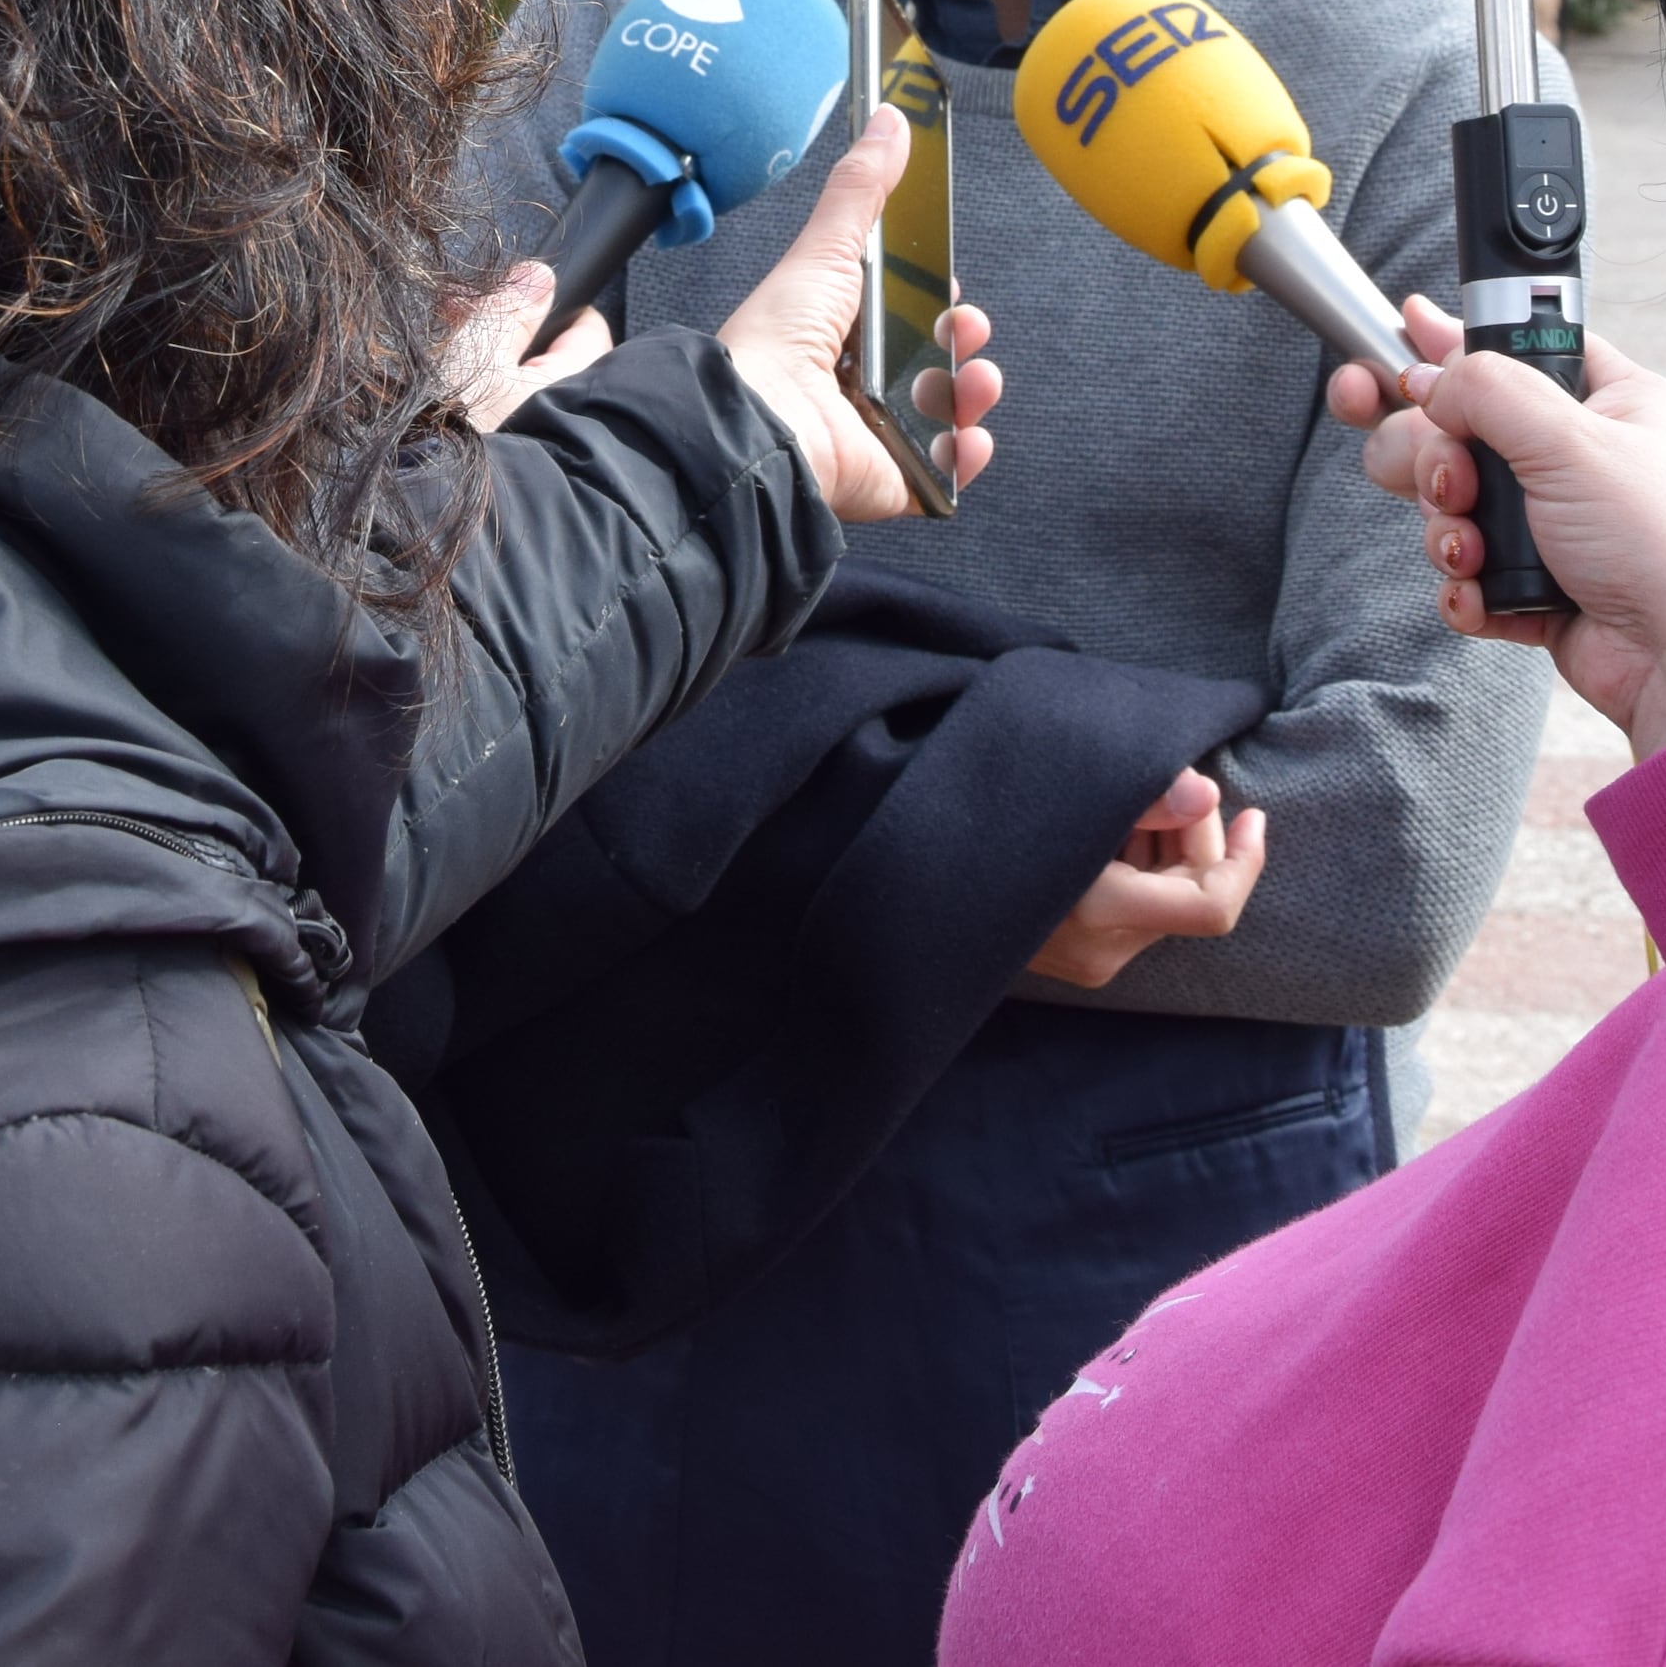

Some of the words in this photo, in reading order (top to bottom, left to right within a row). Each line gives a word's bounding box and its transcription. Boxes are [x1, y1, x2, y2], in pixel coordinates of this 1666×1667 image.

[621, 18, 719, 77] COPE
[1056, 2, 1229, 147] SER
[1511, 328, 1577, 350] SANDA
